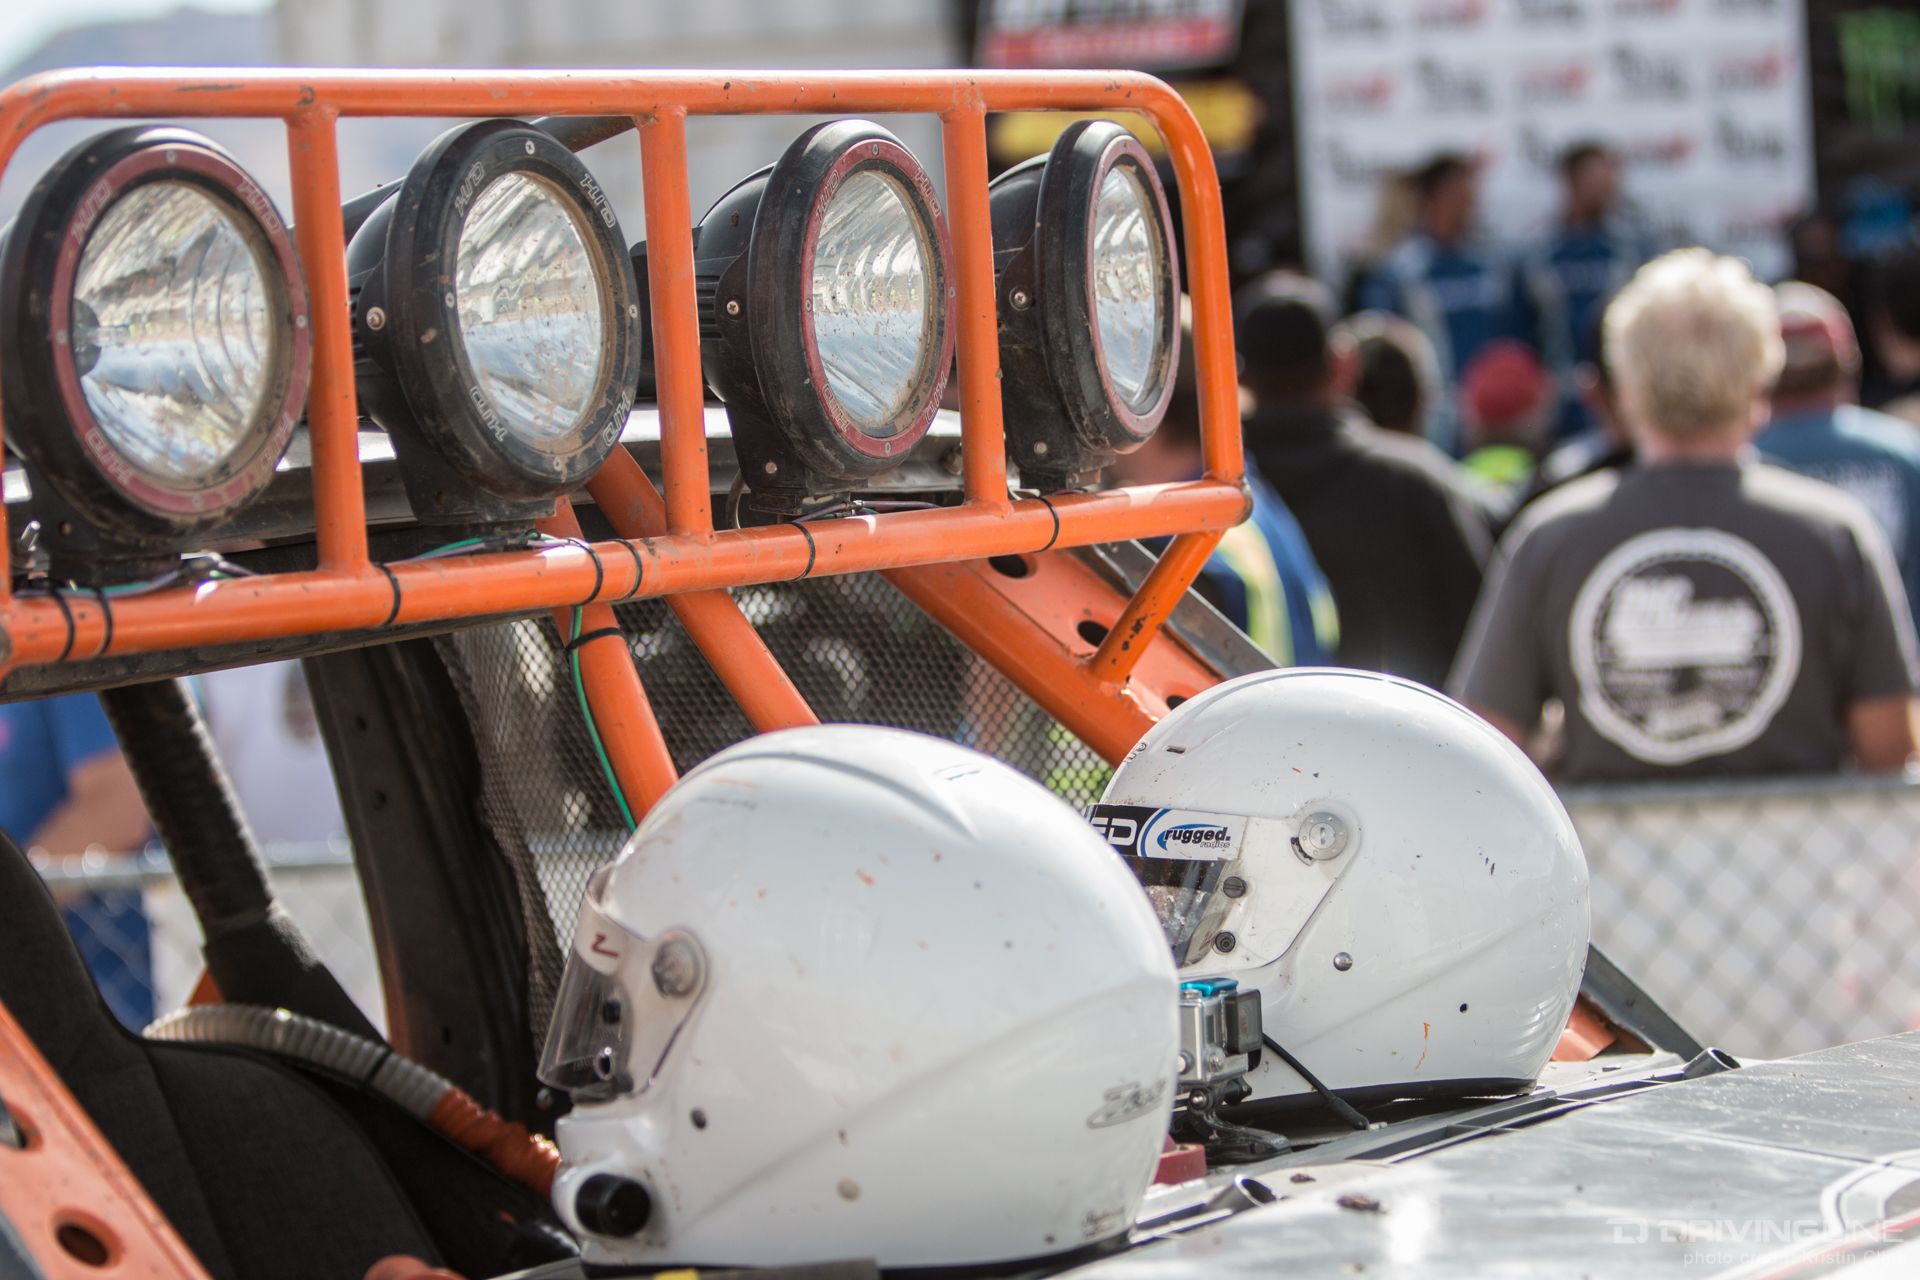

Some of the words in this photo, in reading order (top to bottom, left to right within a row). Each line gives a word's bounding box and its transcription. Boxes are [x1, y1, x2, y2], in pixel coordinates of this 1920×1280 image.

[71, 178, 112, 245] HID
[236, 175, 281, 235] HID
[454, 161, 485, 218] HID
[579, 173, 616, 229] HID
[816, 169, 840, 224] HID
[914, 166, 942, 218] HID
[470, 385, 509, 443] HID
[602, 391, 632, 447] HID
[822, 382, 851, 433] HID
[923, 370, 948, 426] HID
[84, 426, 134, 486] HID
[1199, 840, 1231, 849] radios
